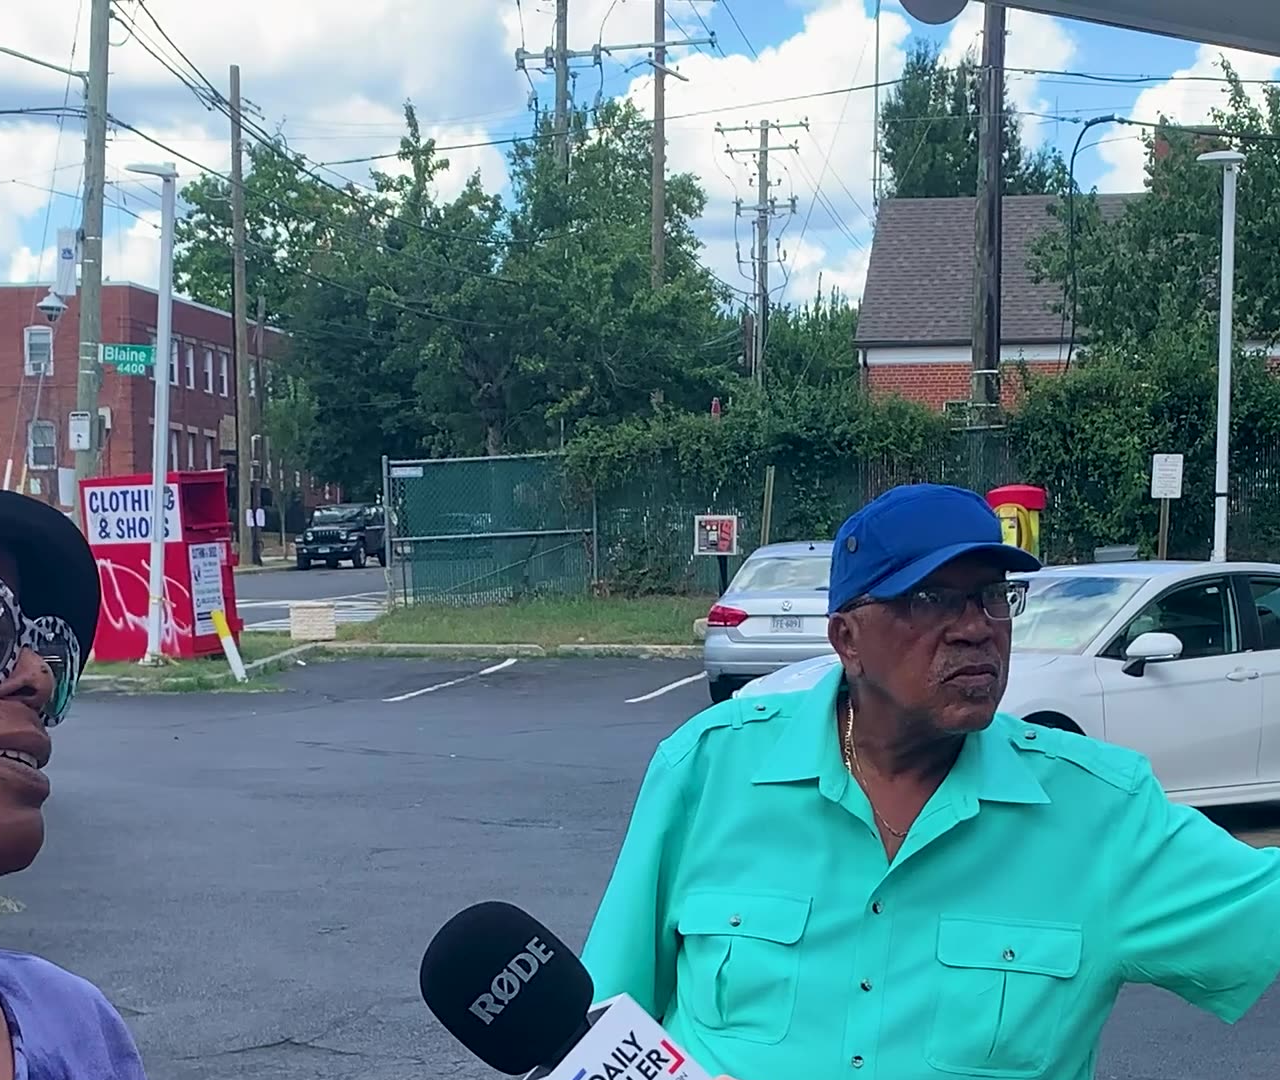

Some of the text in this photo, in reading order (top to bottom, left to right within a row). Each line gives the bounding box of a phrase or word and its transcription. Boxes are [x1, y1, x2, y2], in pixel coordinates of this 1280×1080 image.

[104, 346, 147, 362] Blaine
[117, 363, 145, 374] 4400
[89, 489, 175, 514] CLOTHIG
[98, 516, 169, 540] & SHOS
[468, 936, 555, 1025] RØDE
